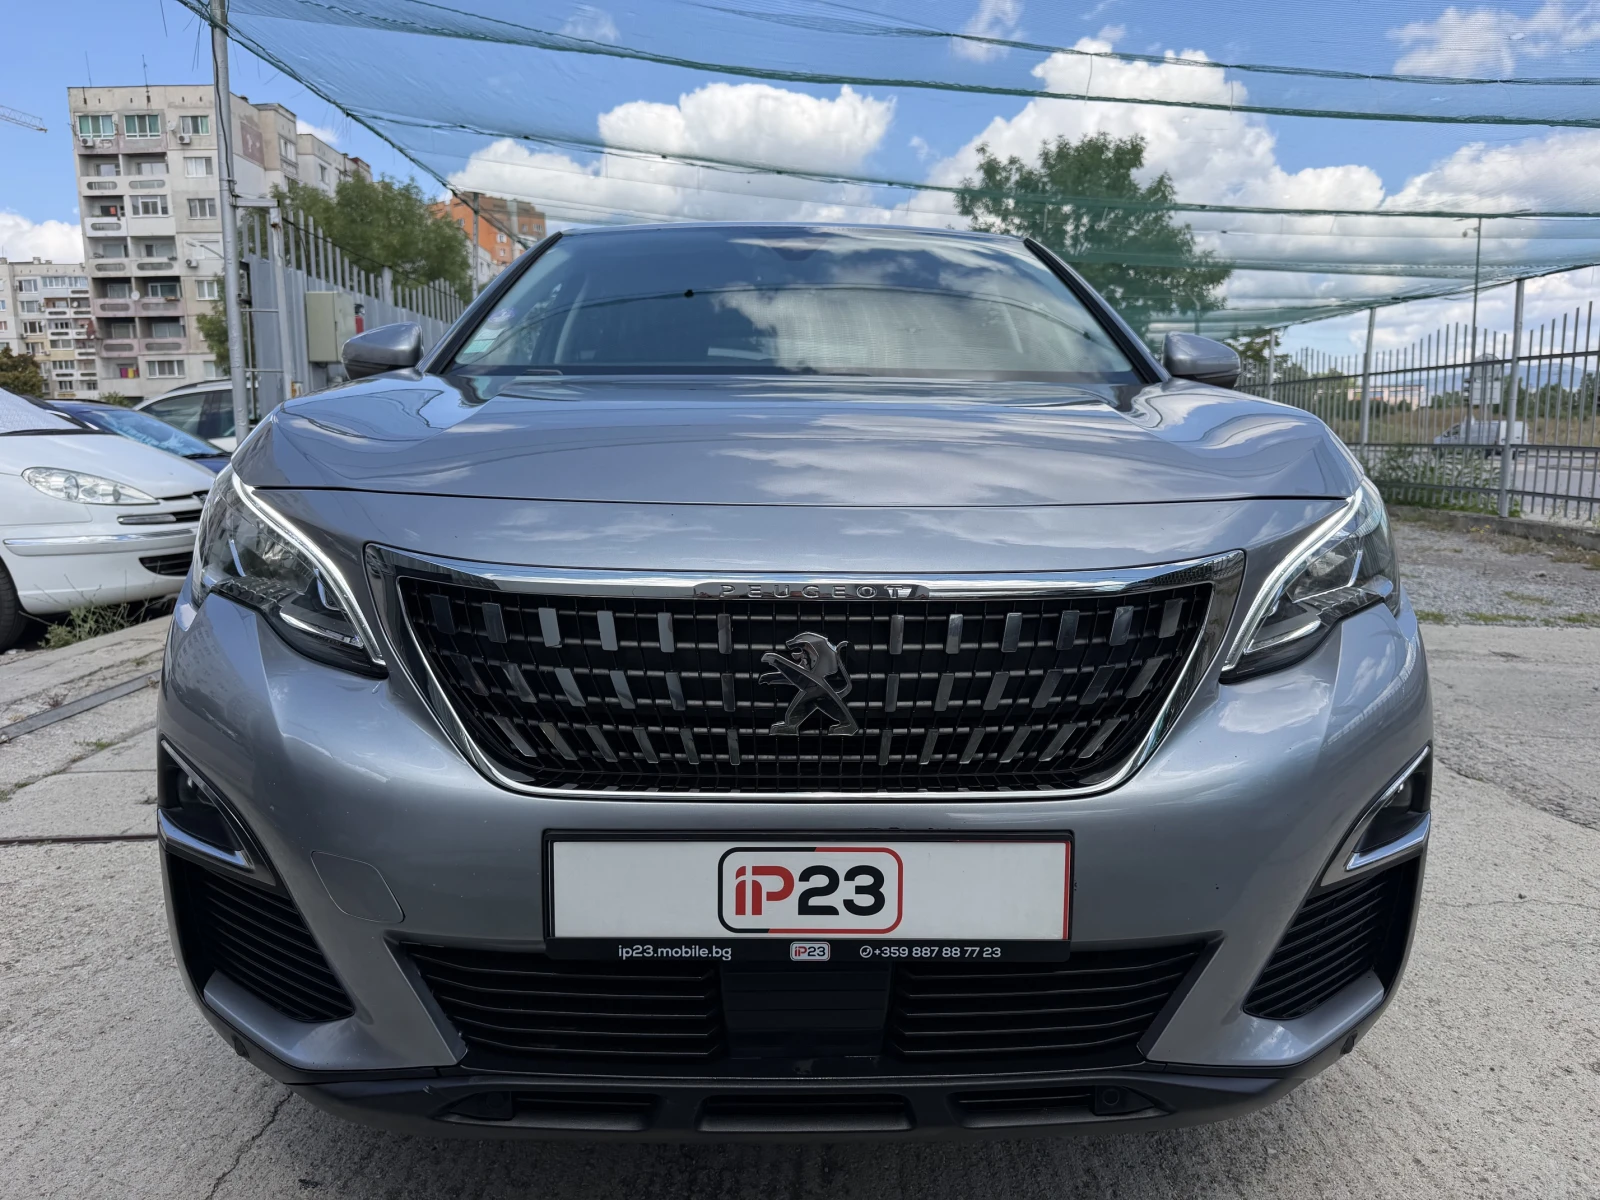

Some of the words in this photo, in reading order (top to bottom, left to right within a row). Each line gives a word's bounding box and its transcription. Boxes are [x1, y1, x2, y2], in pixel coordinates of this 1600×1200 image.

[719, 584, 904, 599] PEUGEOT
[618, 945, 732, 961] ip23.mobile.bg
[873, 946, 909, 958] +359
[912, 946, 939, 958] 887
[942, 946, 961, 958] 88
[963, 946, 981, 958] 77
[982, 946, 1002, 958] 23
